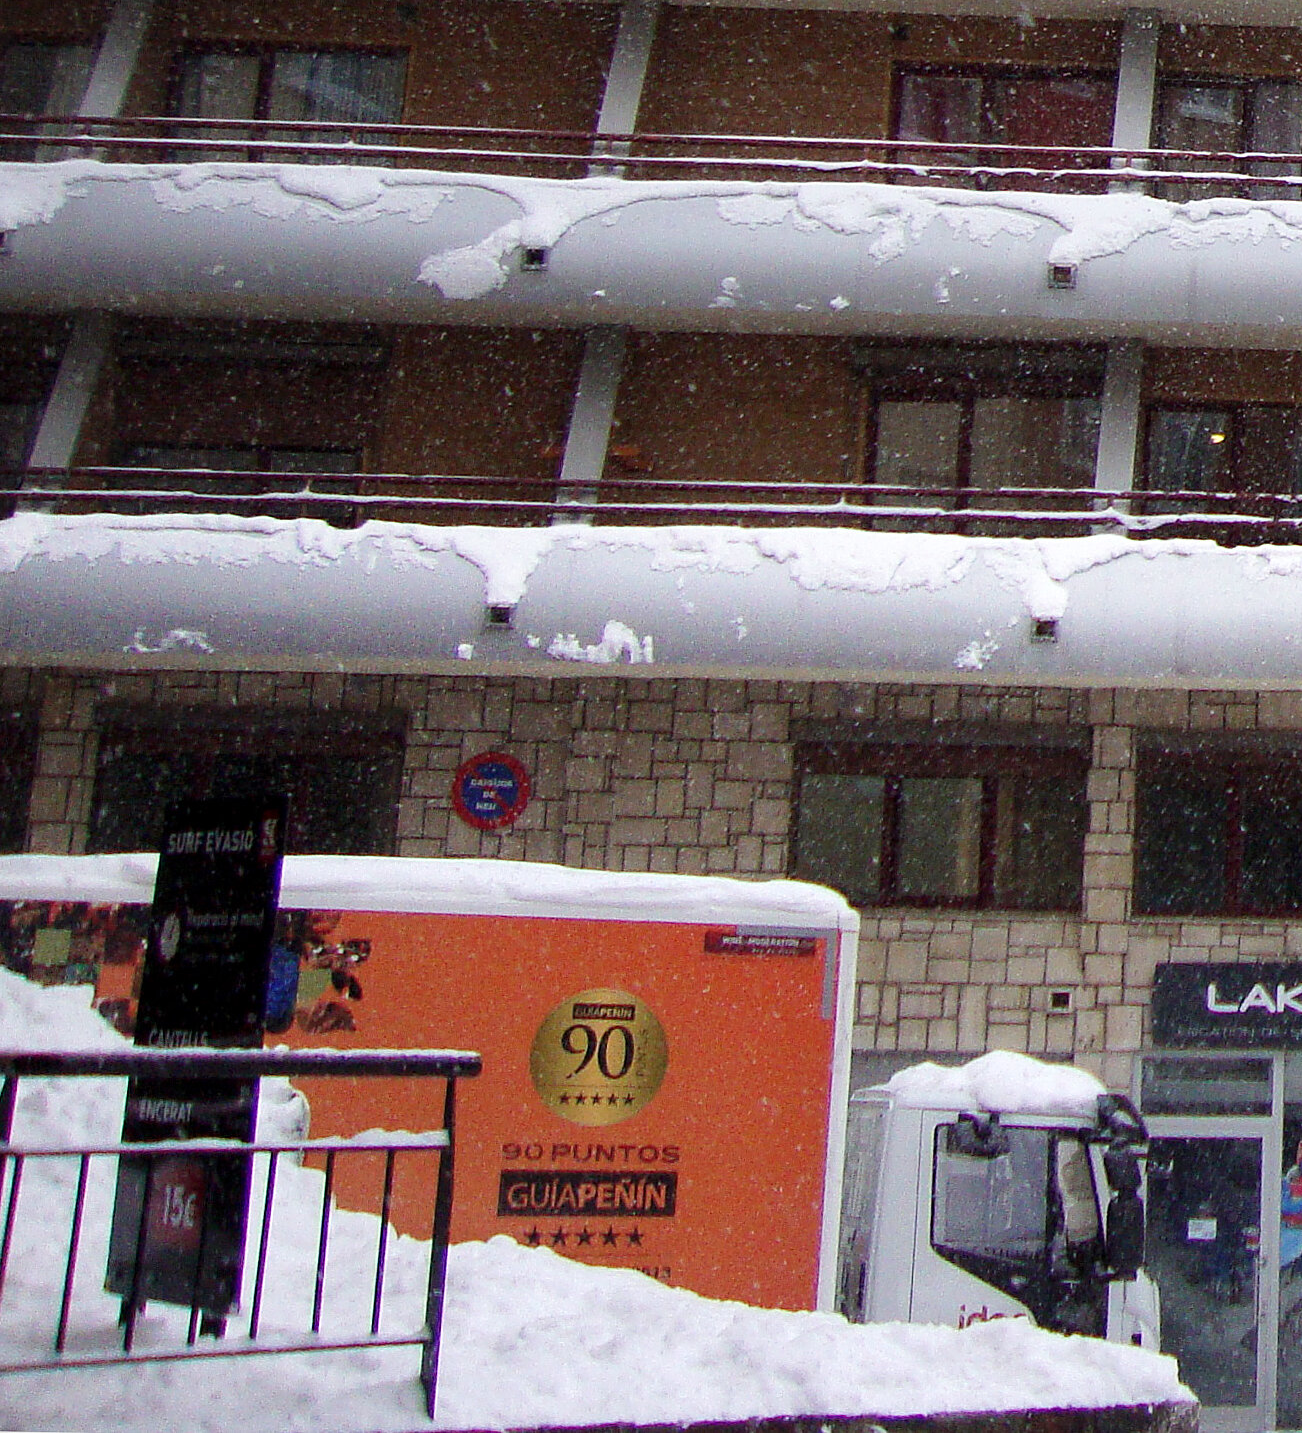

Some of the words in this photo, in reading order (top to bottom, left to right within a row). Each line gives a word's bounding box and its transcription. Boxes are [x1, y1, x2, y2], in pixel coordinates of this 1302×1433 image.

[167, 830, 203, 854] SURF
[561, 1024, 635, 1079] 90
[502, 1143, 543, 1160] 90
[551, 1143, 680, 1164] PUNTOS
